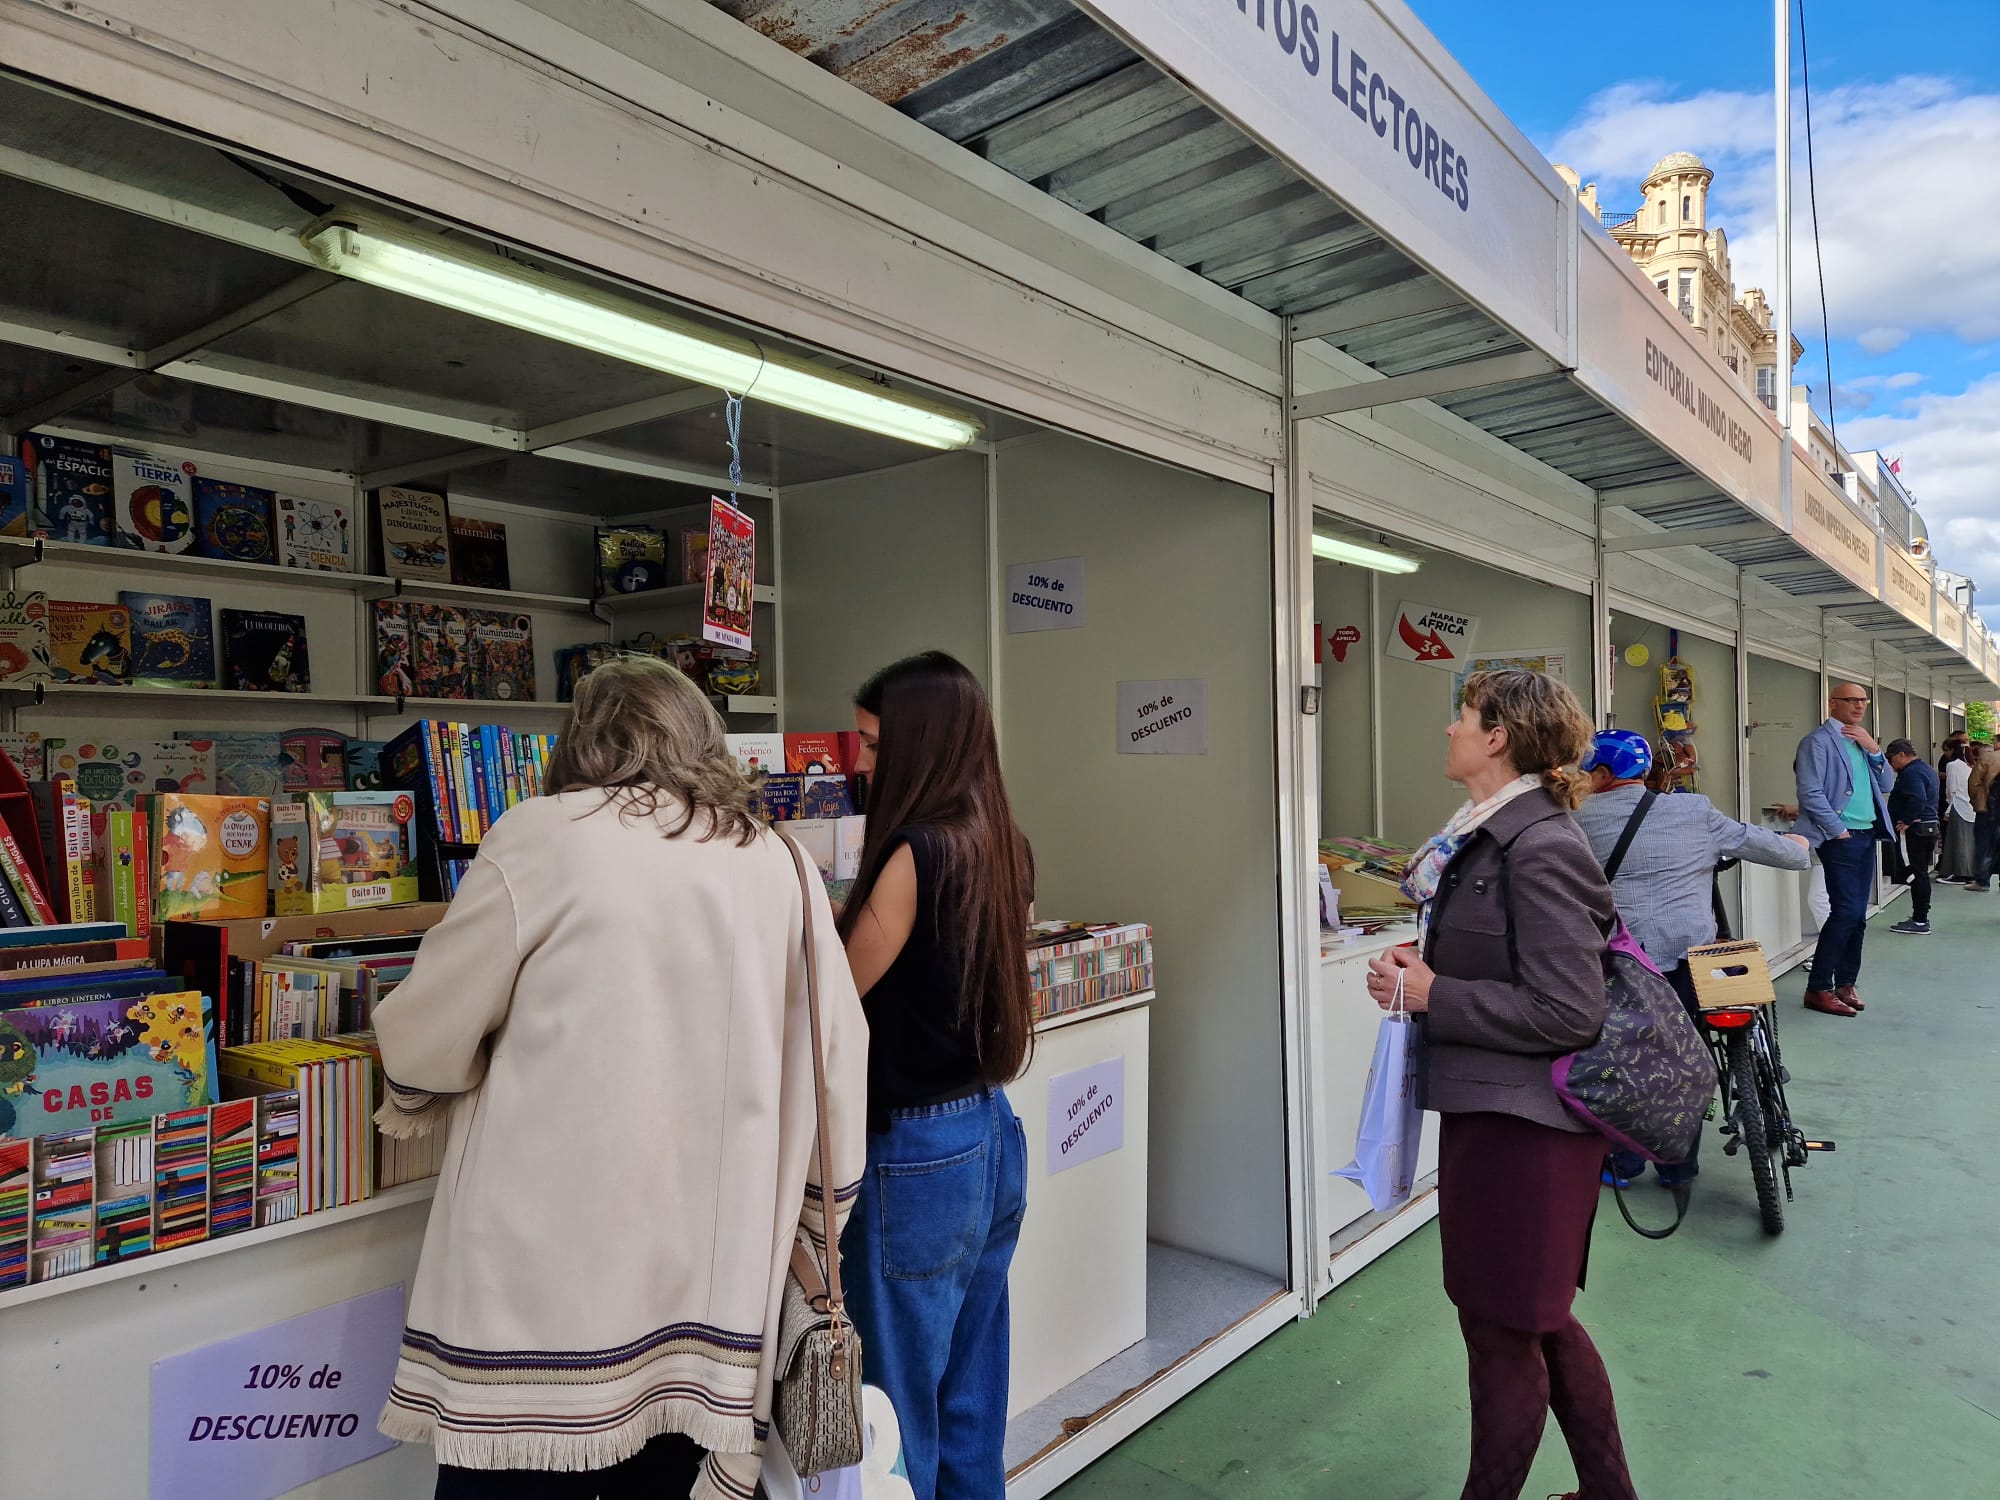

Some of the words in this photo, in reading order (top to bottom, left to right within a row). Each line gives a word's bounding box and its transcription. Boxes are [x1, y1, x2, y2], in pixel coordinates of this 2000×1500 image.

[1332, 30, 1469, 212] LECTORES
[1646, 337, 1696, 417] EDITORIAL
[1698, 387, 1727, 442] MUNDO
[1728, 416, 1752, 464] NEGRO
[132, 465, 183, 484] TIERRA
[382, 500, 440, 517] MAJESTUOSO
[386, 518, 443, 533] DINOSAURIOS
[453, 526, 505, 541] animales
[310, 552, 346, 566] CIENCIA
[1028, 574, 1049, 589] 10%
[1051, 579, 1065, 592] de
[1012, 592, 1073, 615] DESCUENTO
[1417, 614, 1465, 637] ÁFRICA
[1430, 610, 1454, 623] MAPA
[1456, 617, 1469, 626] DE
[478, 626, 524, 640] iluminatlas
[1421, 640, 1442, 657] 3€
[1136, 702, 1159, 718] 10%
[1160, 694, 1174, 708] de
[1130, 706, 1192, 742] DESCUENTO
[739, 746, 772, 756] Federico
[797, 744, 829, 754] Federico
[66, 810, 76, 829] Tito
[80, 814, 89, 829] Tito
[337, 809, 367, 822] Osito
[371, 810, 394, 823] Tito
[68, 832, 79, 858] Osito
[81, 832, 90, 851] Osito
[225, 839, 253, 848] CENAR
[71, 865, 79, 875] de
[71, 878, 80, 897] libro
[352, 888, 370, 898] Osito
[372, 887, 386, 895] Tito
[6, 906, 18, 920] LA
[74, 899, 82, 919] gran
[16, 961, 28, 969] LA
[29, 958, 52, 969] LUPA
[53, 955, 86, 968] MÁGICA
[43, 998, 69, 1006] LIBRO
[71, 992, 112, 1003] LINTERNA
[43, 1075, 154, 1113] CASAS
[1066, 1094, 1086, 1122] 10%
[1086, 1084, 1098, 1100] de
[90, 1107, 114, 1122] DE
[1060, 1094, 1113, 1155] DESCUENTO
[243, 1364, 303, 1390] 10%
[308, 1364, 342, 1389] de
[188, 1413, 359, 1442] DESCUENTO
